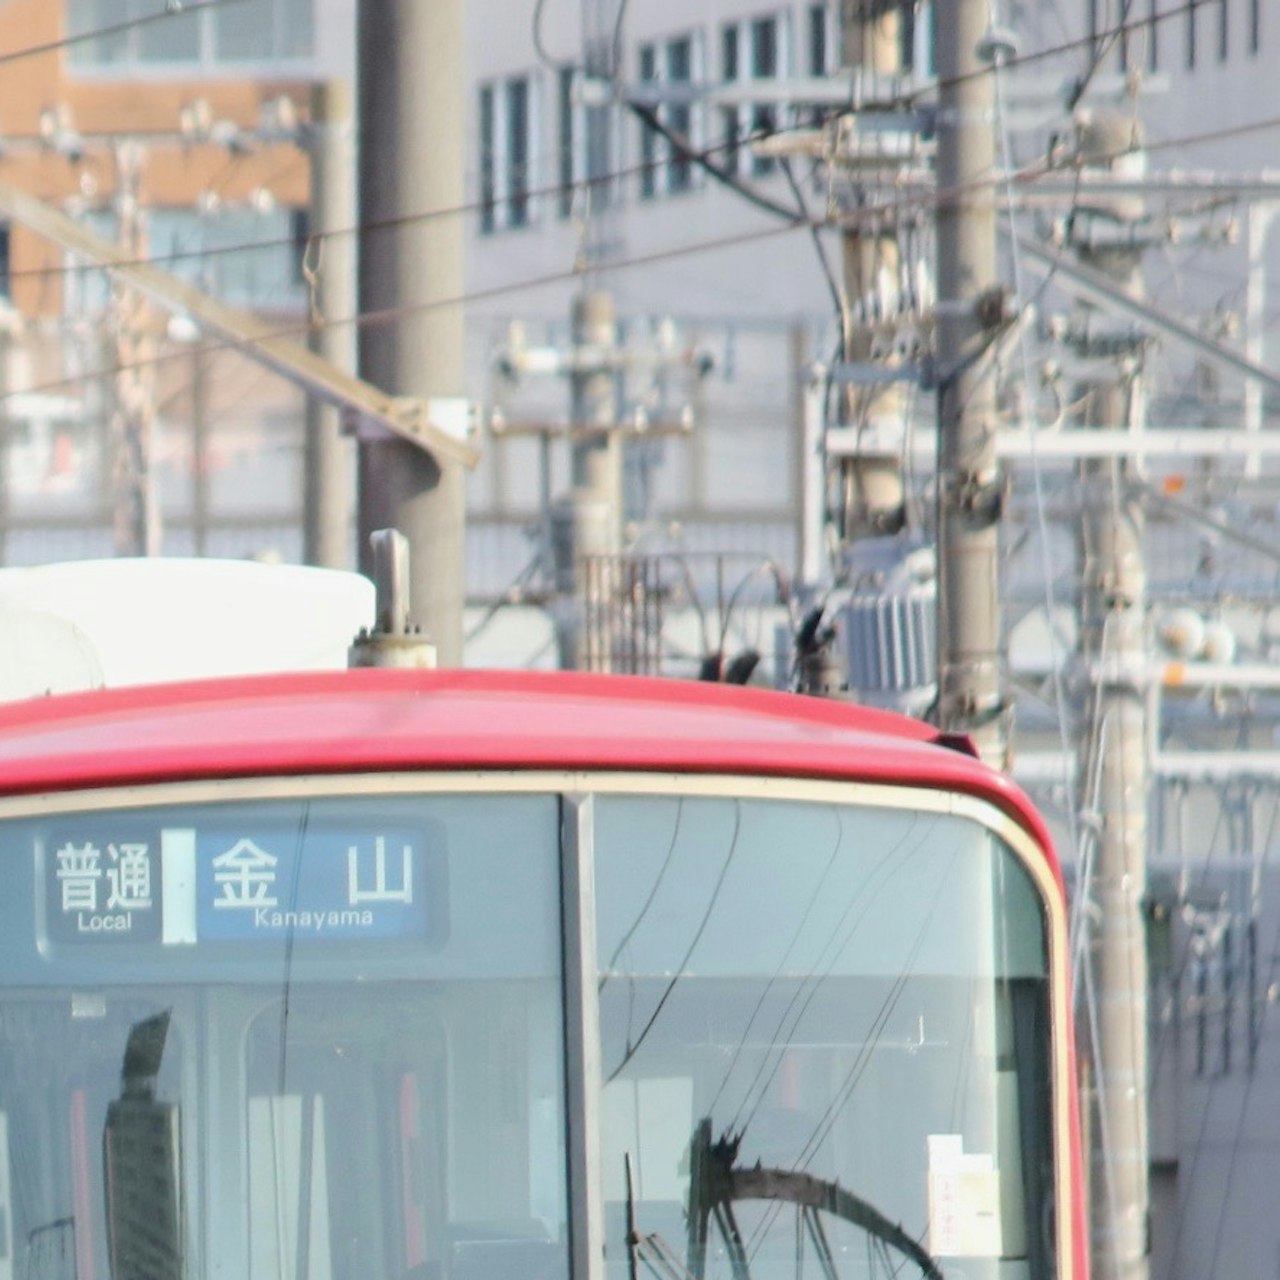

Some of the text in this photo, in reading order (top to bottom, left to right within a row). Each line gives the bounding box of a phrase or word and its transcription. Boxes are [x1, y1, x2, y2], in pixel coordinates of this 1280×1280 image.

[56, 841, 153, 911] 普通
[212, 836, 413, 908] 金山
[77, 912, 132, 932] Local
[254, 907, 374, 930] Kanayama
